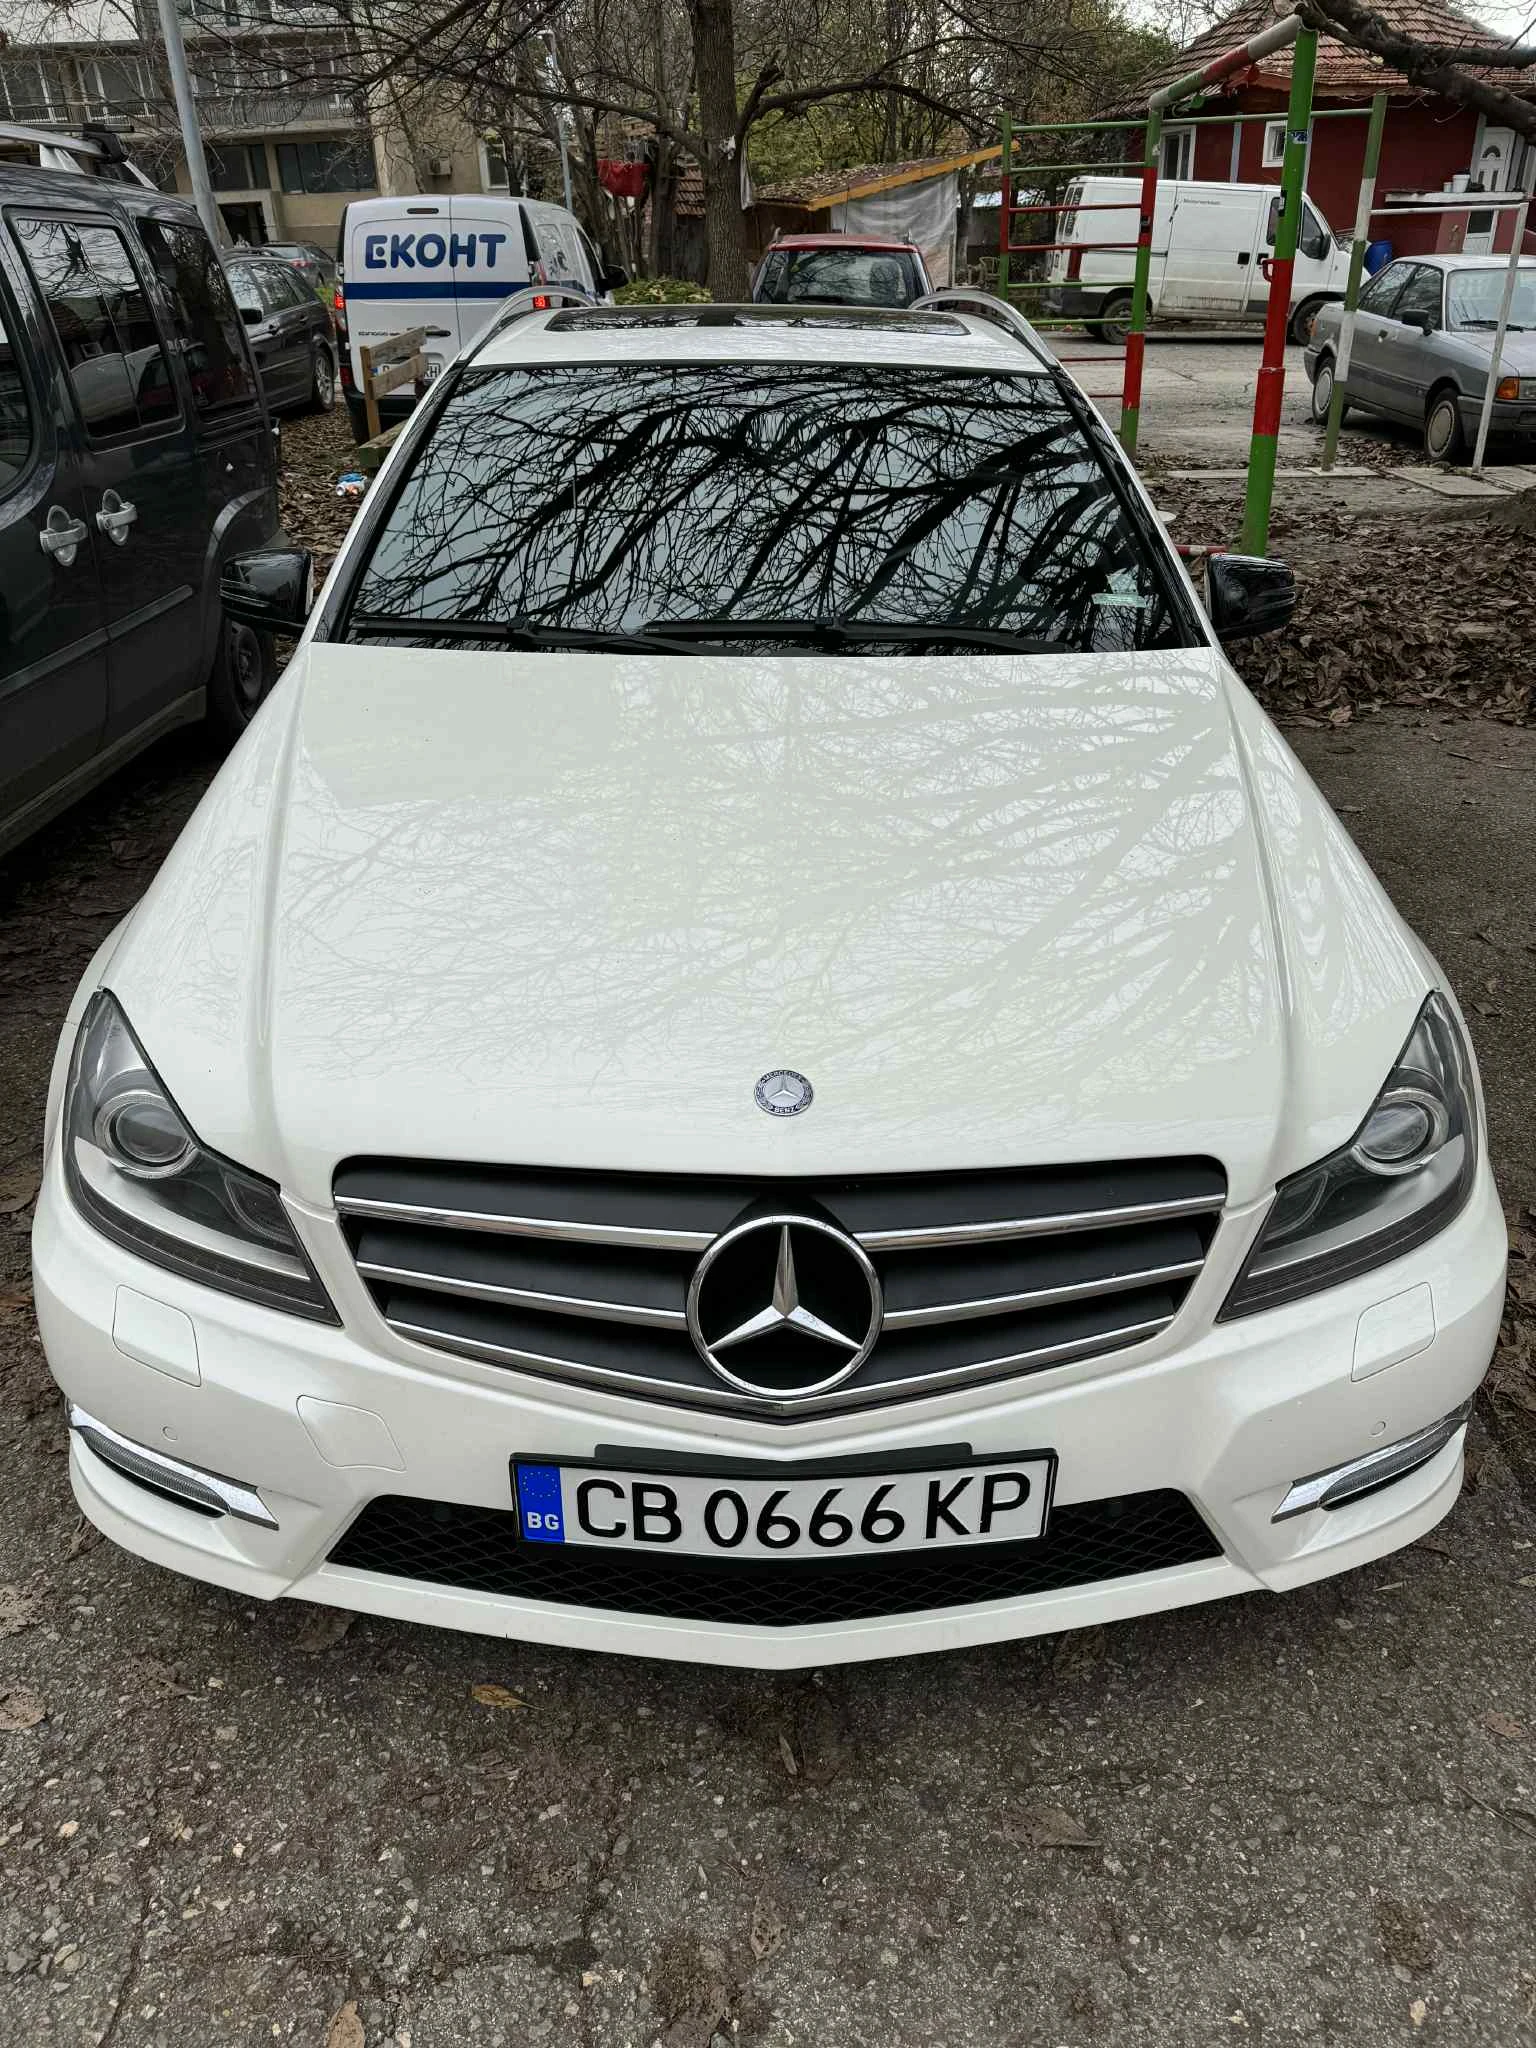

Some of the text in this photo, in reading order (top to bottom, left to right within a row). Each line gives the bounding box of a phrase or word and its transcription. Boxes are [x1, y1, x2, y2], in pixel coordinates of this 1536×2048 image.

[364, 233, 507, 269] ЕКОНТ
[527, 1511, 560, 1530] BG
[576, 1471, 1031, 1548] CB 0666 KP
